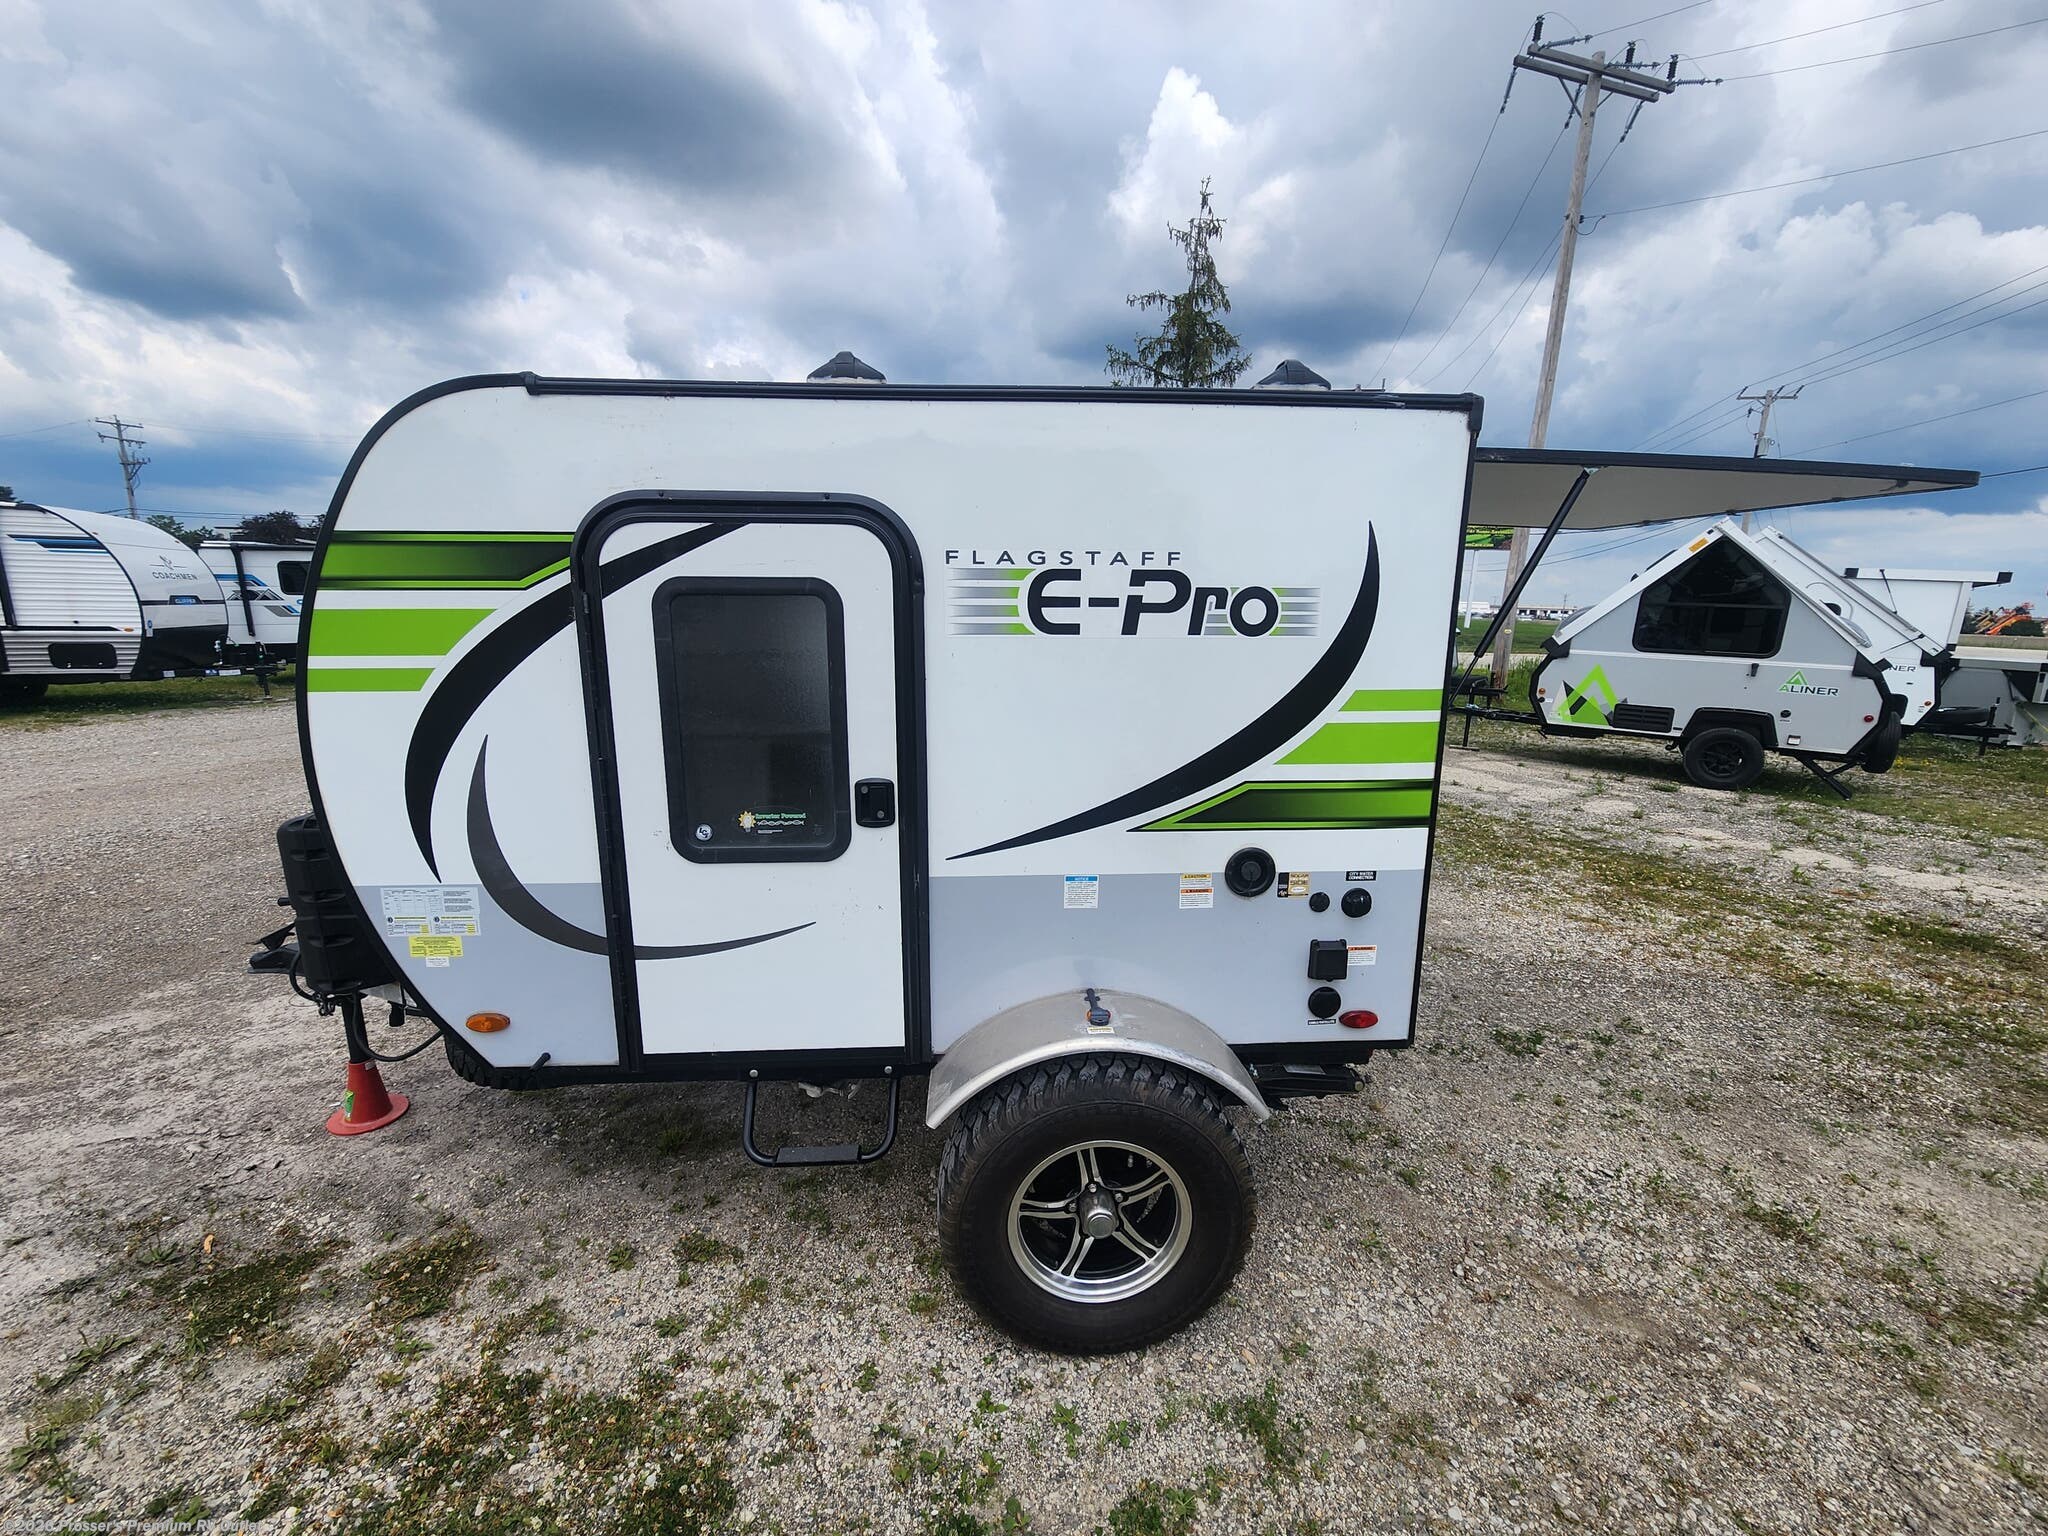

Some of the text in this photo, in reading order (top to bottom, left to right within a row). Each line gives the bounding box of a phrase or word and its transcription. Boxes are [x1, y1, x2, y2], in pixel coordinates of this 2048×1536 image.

[944, 550, 1182, 567] FLAGSTAFF
[151, 571, 198, 581] COACHMEN
[1026, 567, 1280, 638] E-Pro
[1889, 665, 1917, 673] NER
[1779, 684, 1839, 697] ALINER
